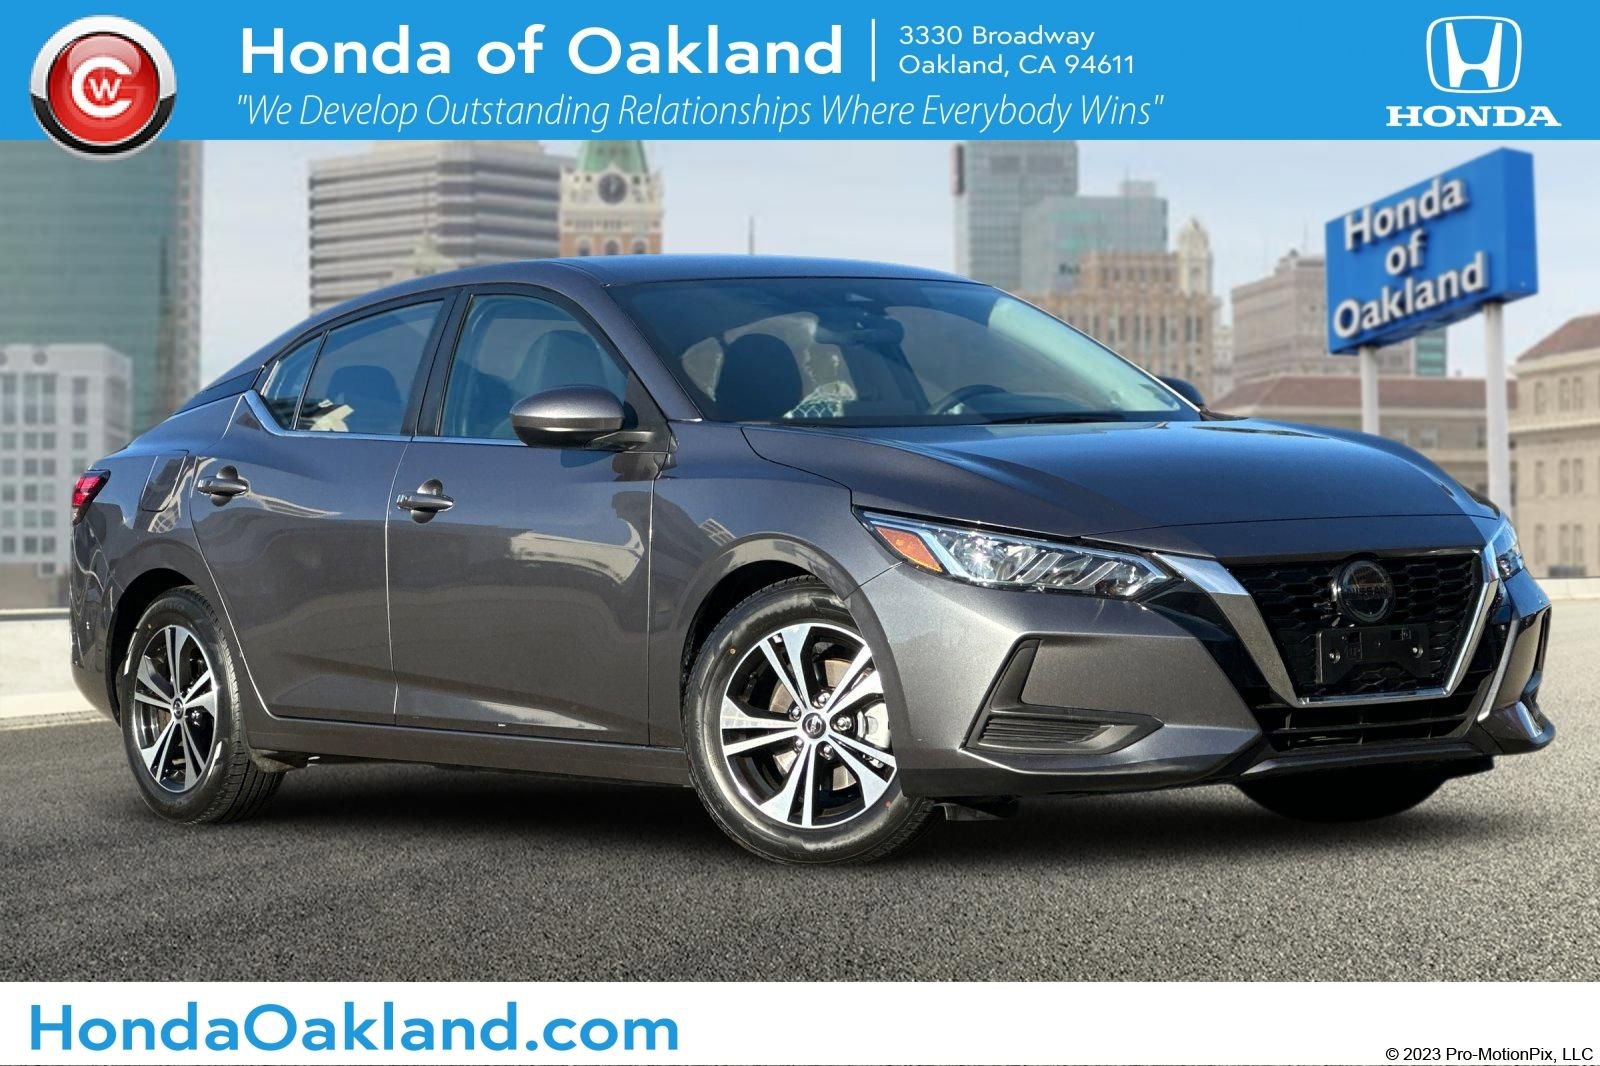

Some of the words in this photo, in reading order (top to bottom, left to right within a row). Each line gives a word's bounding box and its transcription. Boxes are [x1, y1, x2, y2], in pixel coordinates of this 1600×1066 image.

[1343, 175, 1468, 251] Honda
[1385, 227, 1426, 276] of
[1332, 250, 1488, 339] Oakland
